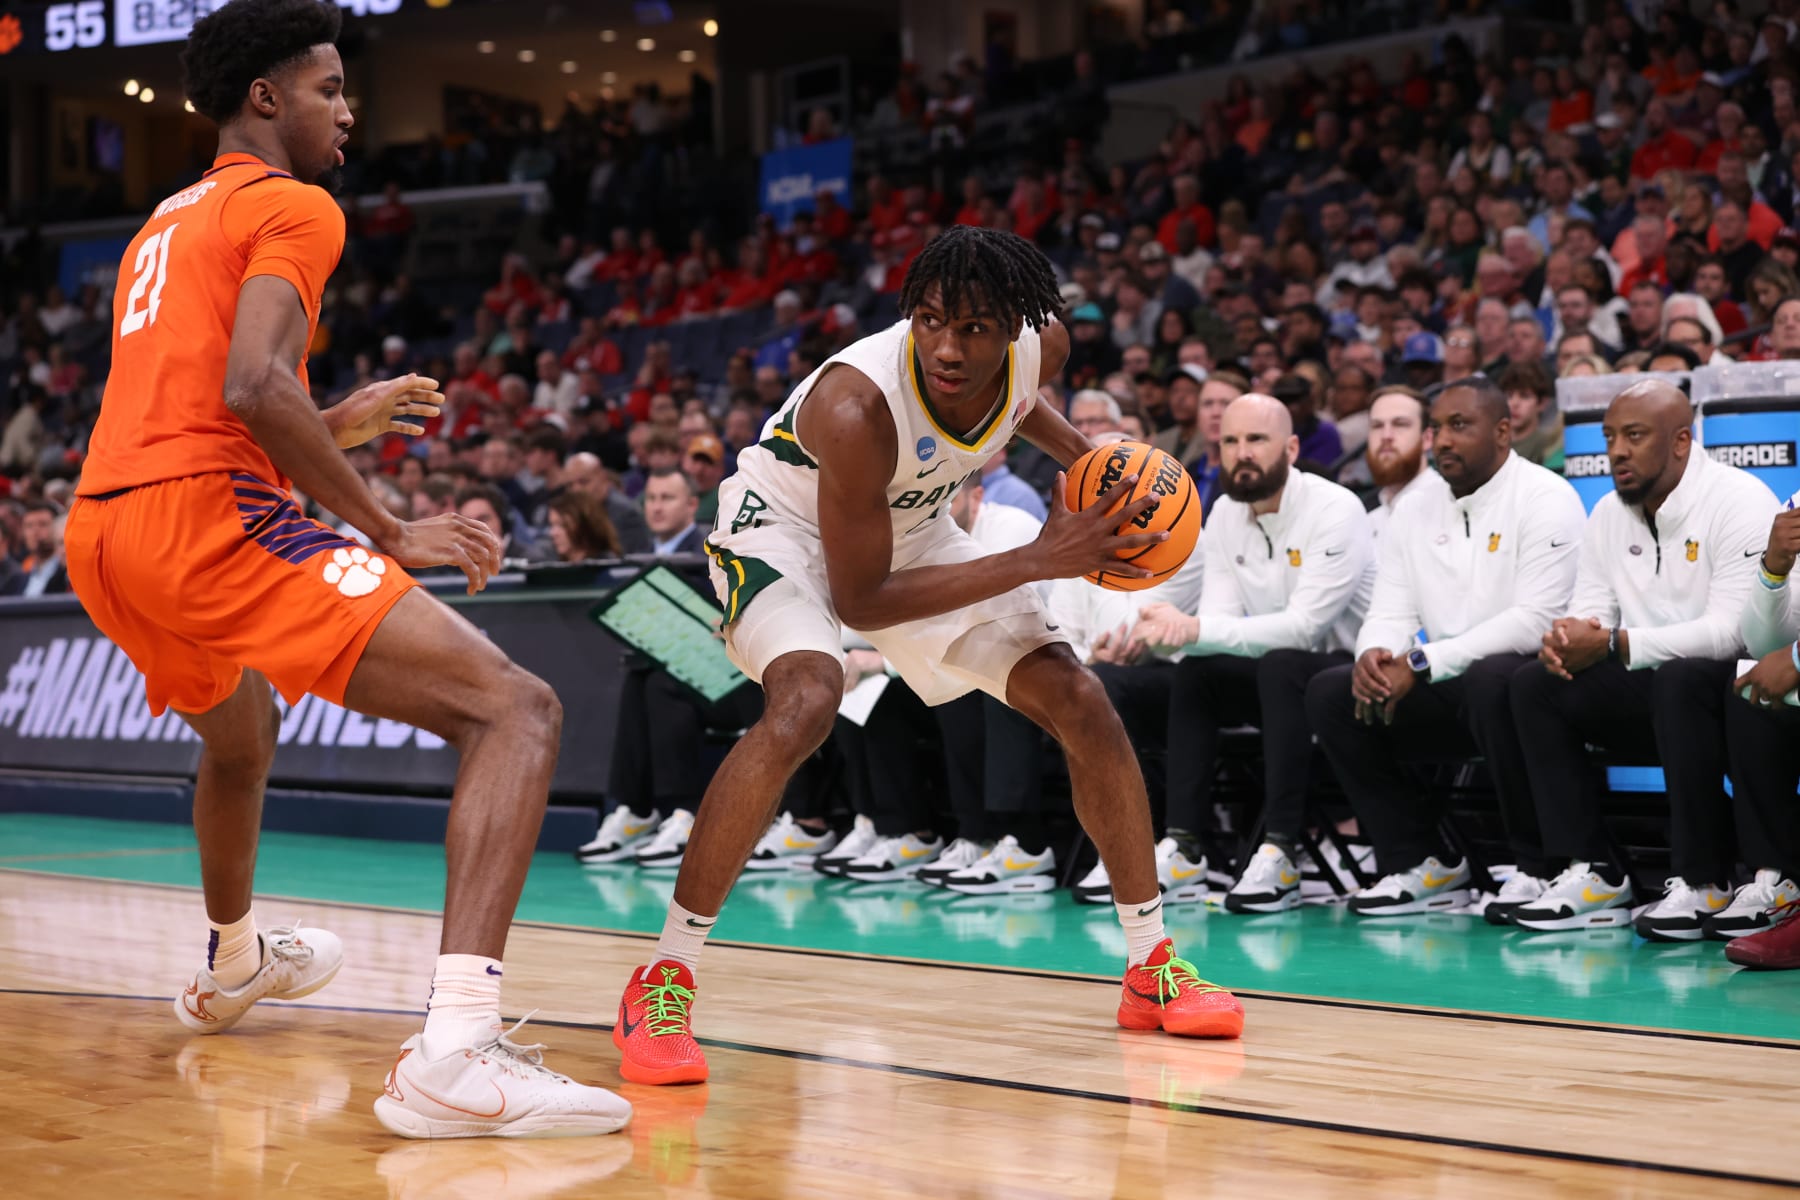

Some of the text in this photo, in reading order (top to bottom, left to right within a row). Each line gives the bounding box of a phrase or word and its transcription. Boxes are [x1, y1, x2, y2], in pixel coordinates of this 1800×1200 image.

[45, 2, 105, 50] 55
[120, 222, 180, 340] 21
[890, 469, 976, 510] BAY
